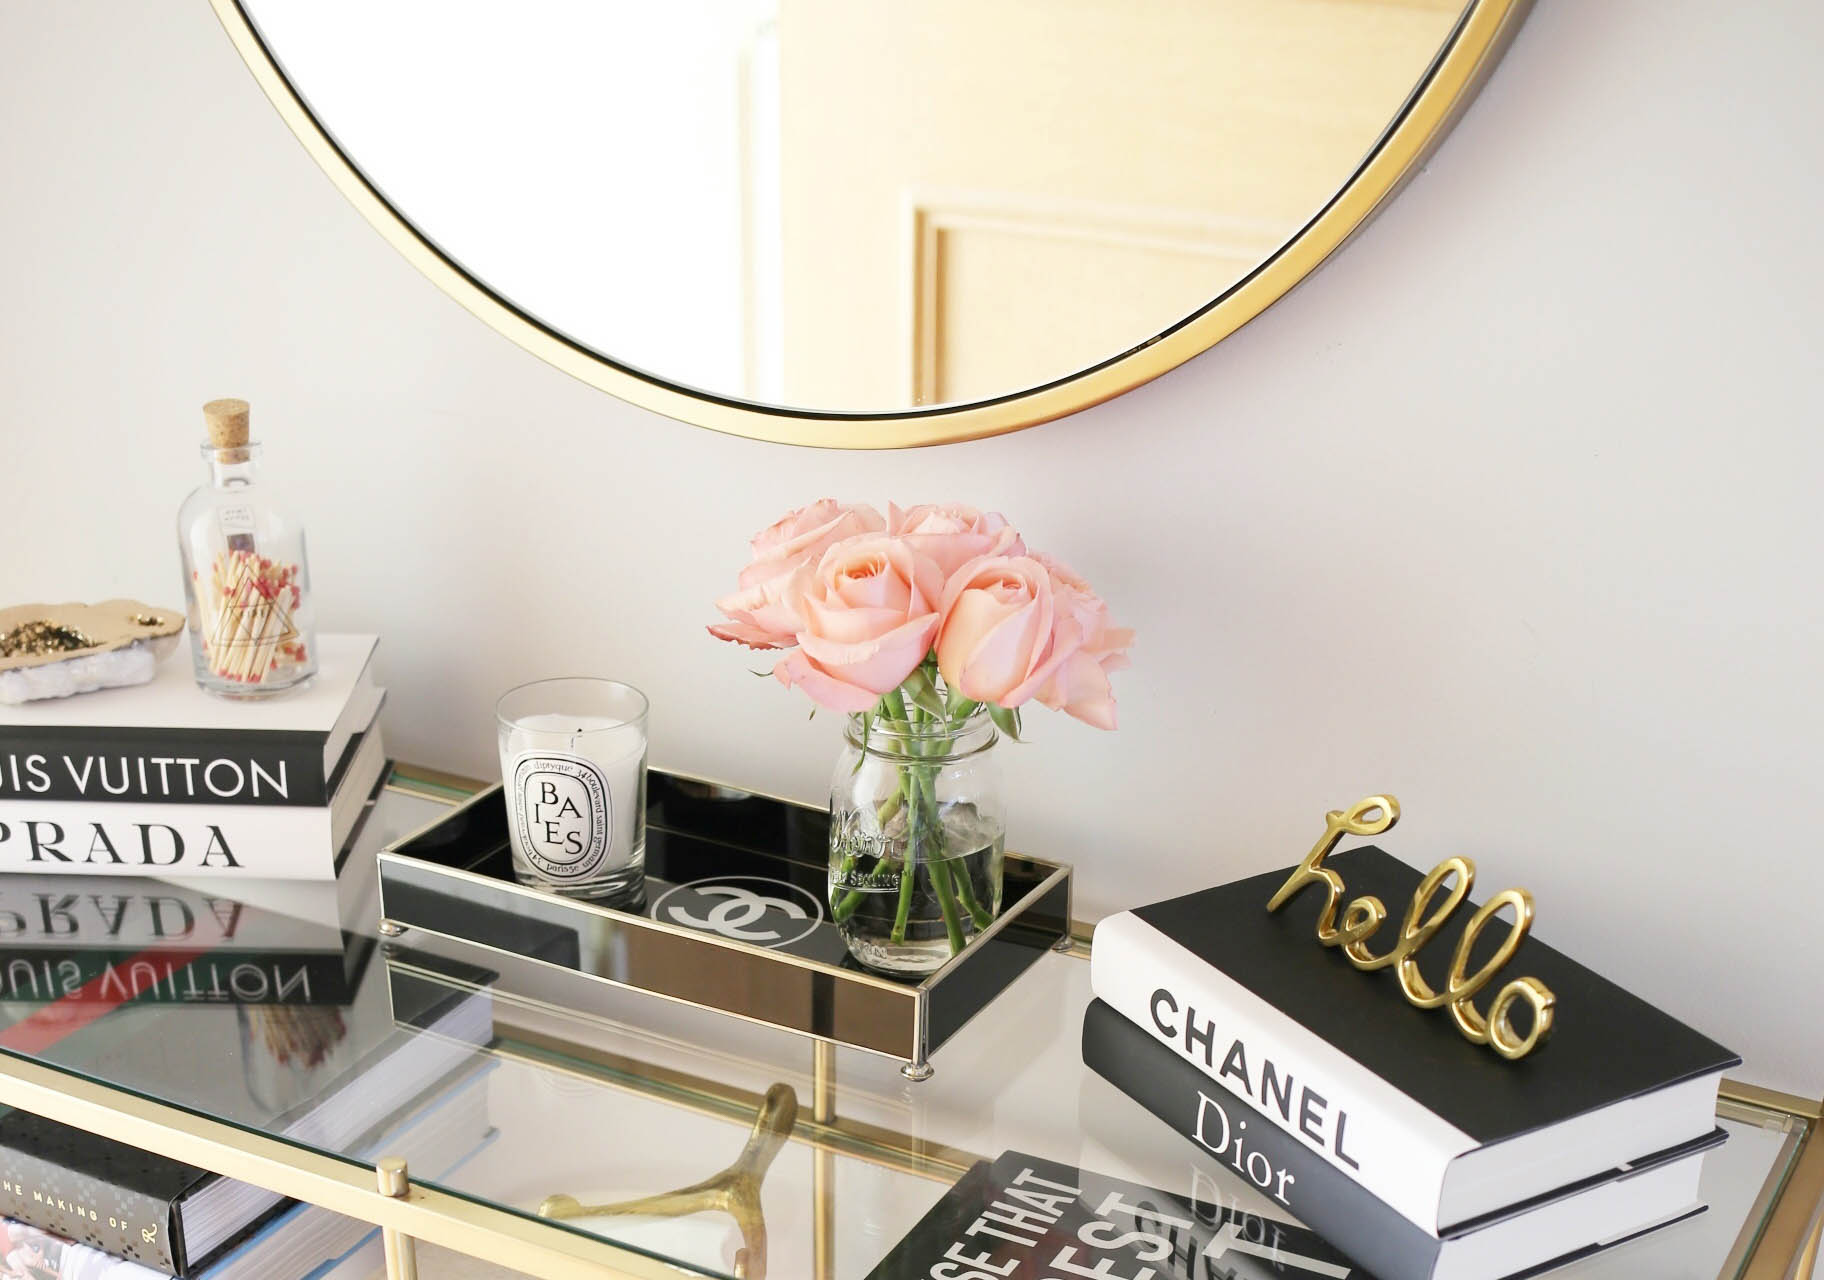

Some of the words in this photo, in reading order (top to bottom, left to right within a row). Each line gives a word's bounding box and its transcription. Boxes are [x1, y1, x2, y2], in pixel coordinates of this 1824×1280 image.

[63, 755, 289, 799] VUITTON
[1266, 794, 1557, 1060] hello
[1150, 988, 1360, 1171] CHANEL
[1191, 1090, 1296, 1206] Dior
[3, 1180, 23, 1196] HE
[33, 1191, 98, 1222] MAKING
[109, 1217, 128, 1231] OF
[966, 1167, 1084, 1248] THAT
